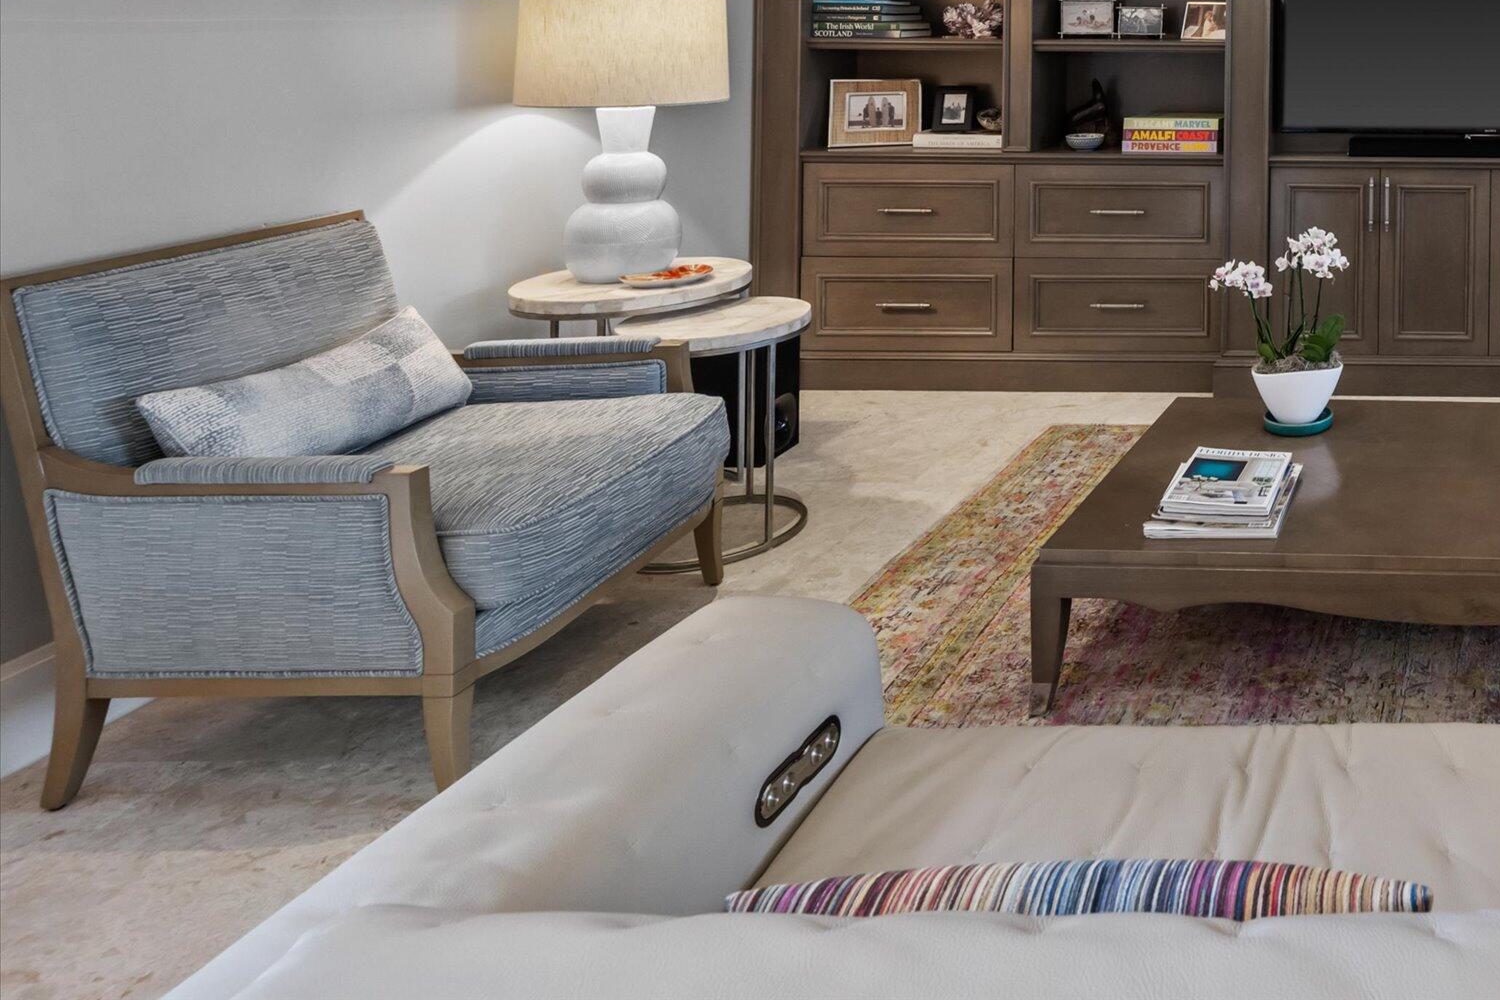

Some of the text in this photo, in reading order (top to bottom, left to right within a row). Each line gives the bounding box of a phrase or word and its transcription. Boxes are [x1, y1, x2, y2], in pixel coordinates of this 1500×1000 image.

[1174, 120, 1211, 128] MARVEL
[1131, 130, 1176, 141] AMALFI
[1131, 142, 1180, 151] PROVENCE
